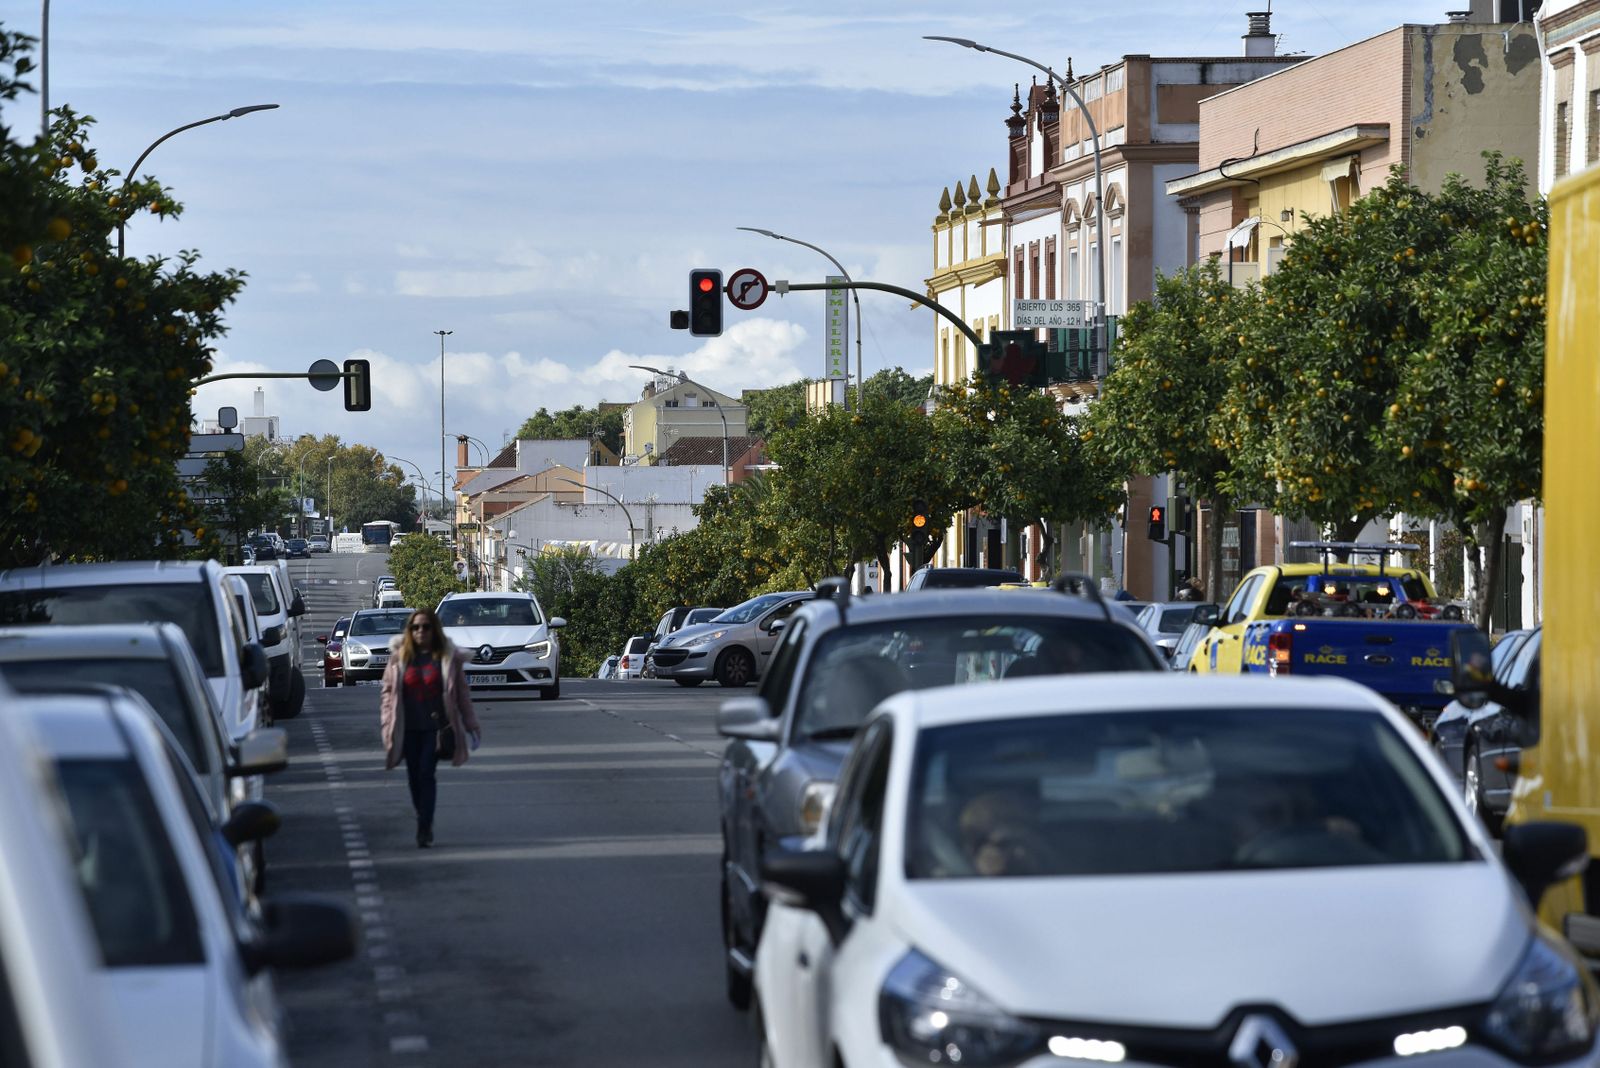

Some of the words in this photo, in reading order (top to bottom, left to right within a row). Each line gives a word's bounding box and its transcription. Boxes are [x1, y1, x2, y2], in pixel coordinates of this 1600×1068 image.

[1017, 302, 1046, 312] ABIERTO
[1050, 302, 1063, 312] LOS
[1067, 302, 1080, 312] 365
[1017, 314, 1031, 325] DÍAS
[1034, 316, 1046, 325] DEL
[1304, 654, 1347, 664] RACE
[1411, 656, 1453, 667] RACE
